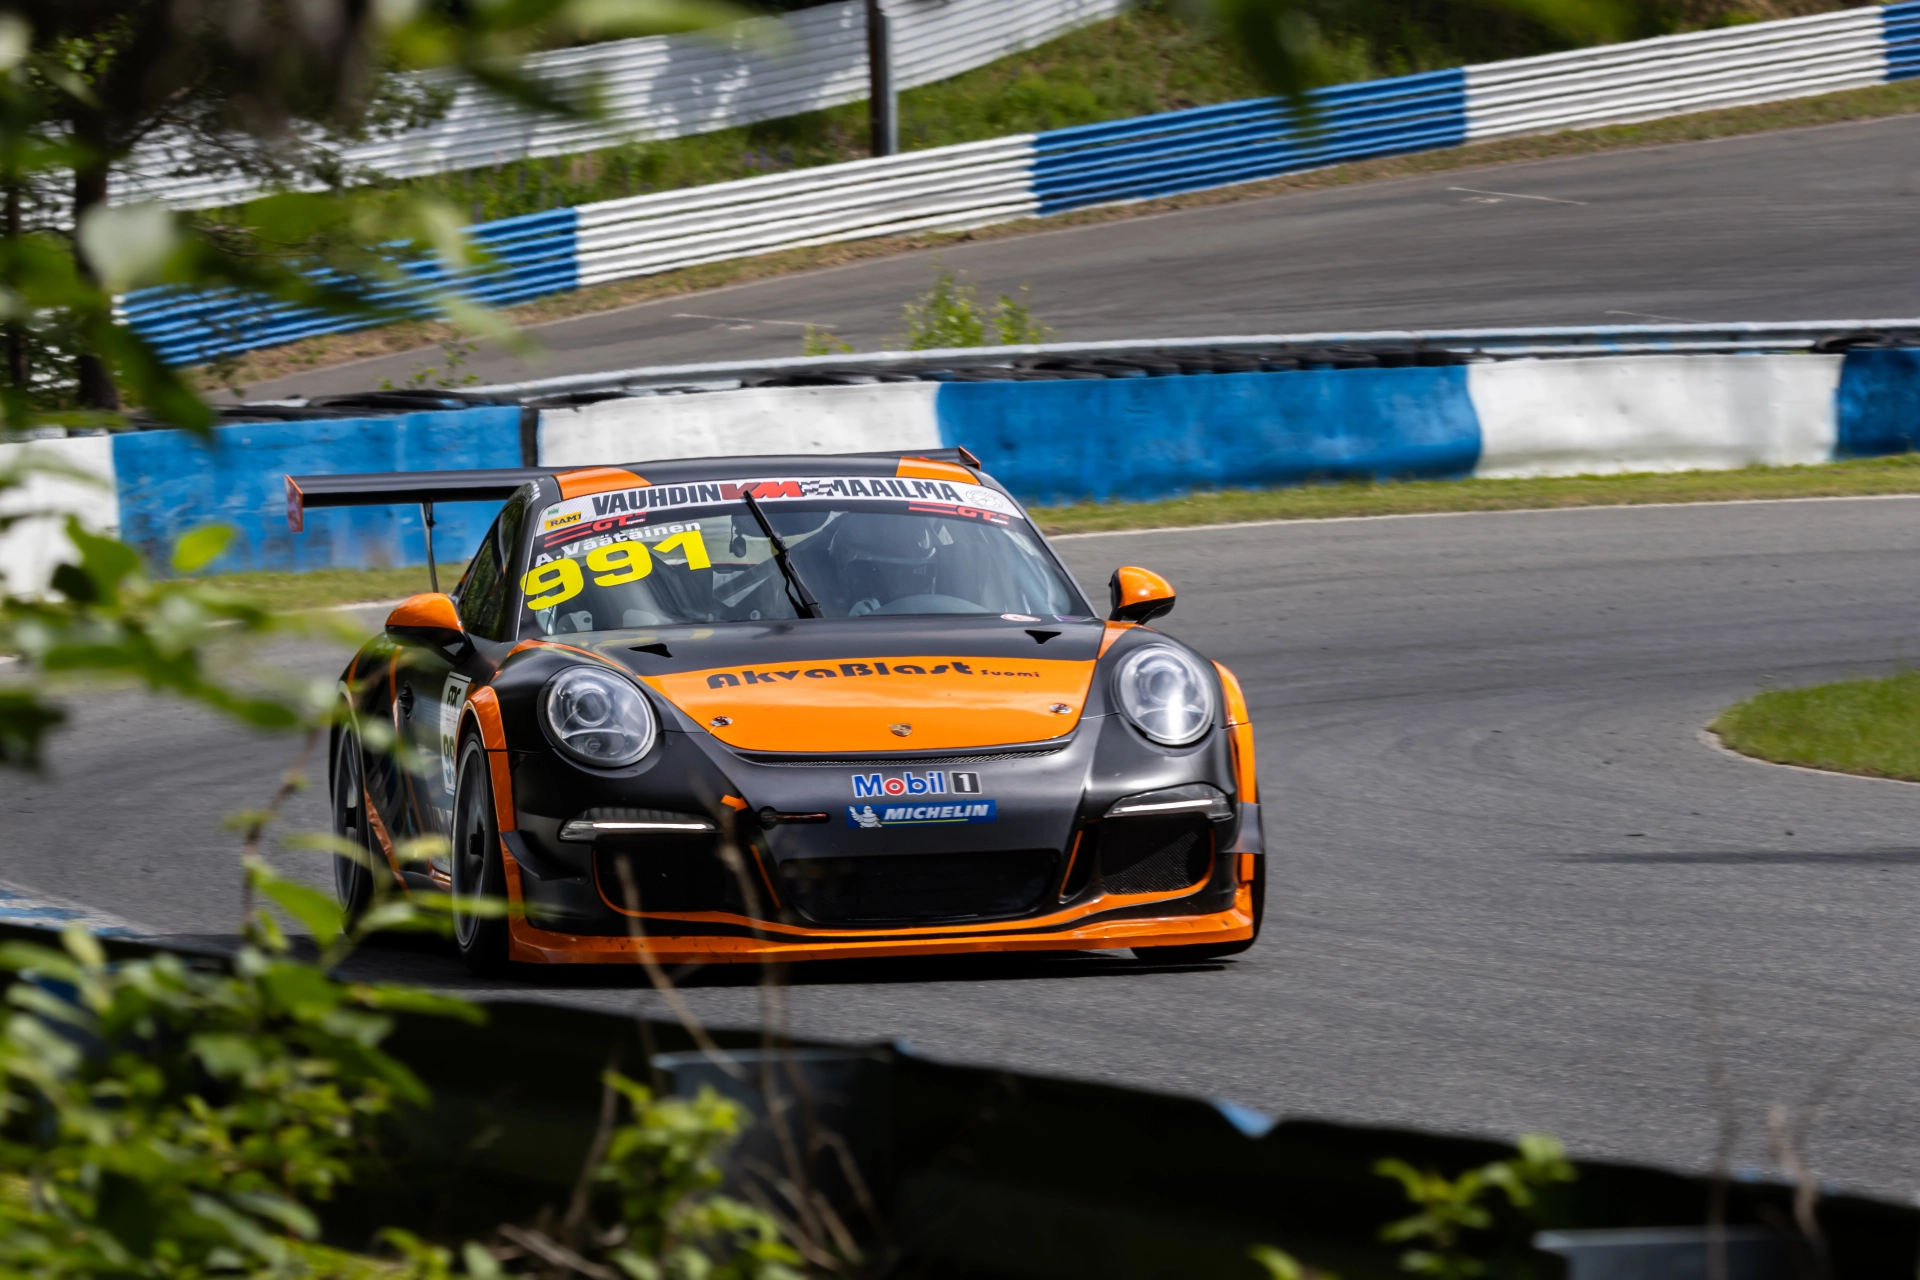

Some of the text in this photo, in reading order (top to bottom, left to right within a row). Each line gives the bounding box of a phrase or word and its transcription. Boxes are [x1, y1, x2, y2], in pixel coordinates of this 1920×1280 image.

[591, 483, 722, 516] VAUHDIN
[827, 479, 965, 502] MAAILMA
[592, 512, 636, 532] GT
[956, 506, 997, 522] GT
[520, 530, 711, 611] 991
[706, 661, 973, 690] AkvaBlast
[852, 771, 946, 798] Mobil
[884, 804, 990, 820] MICHELIN
